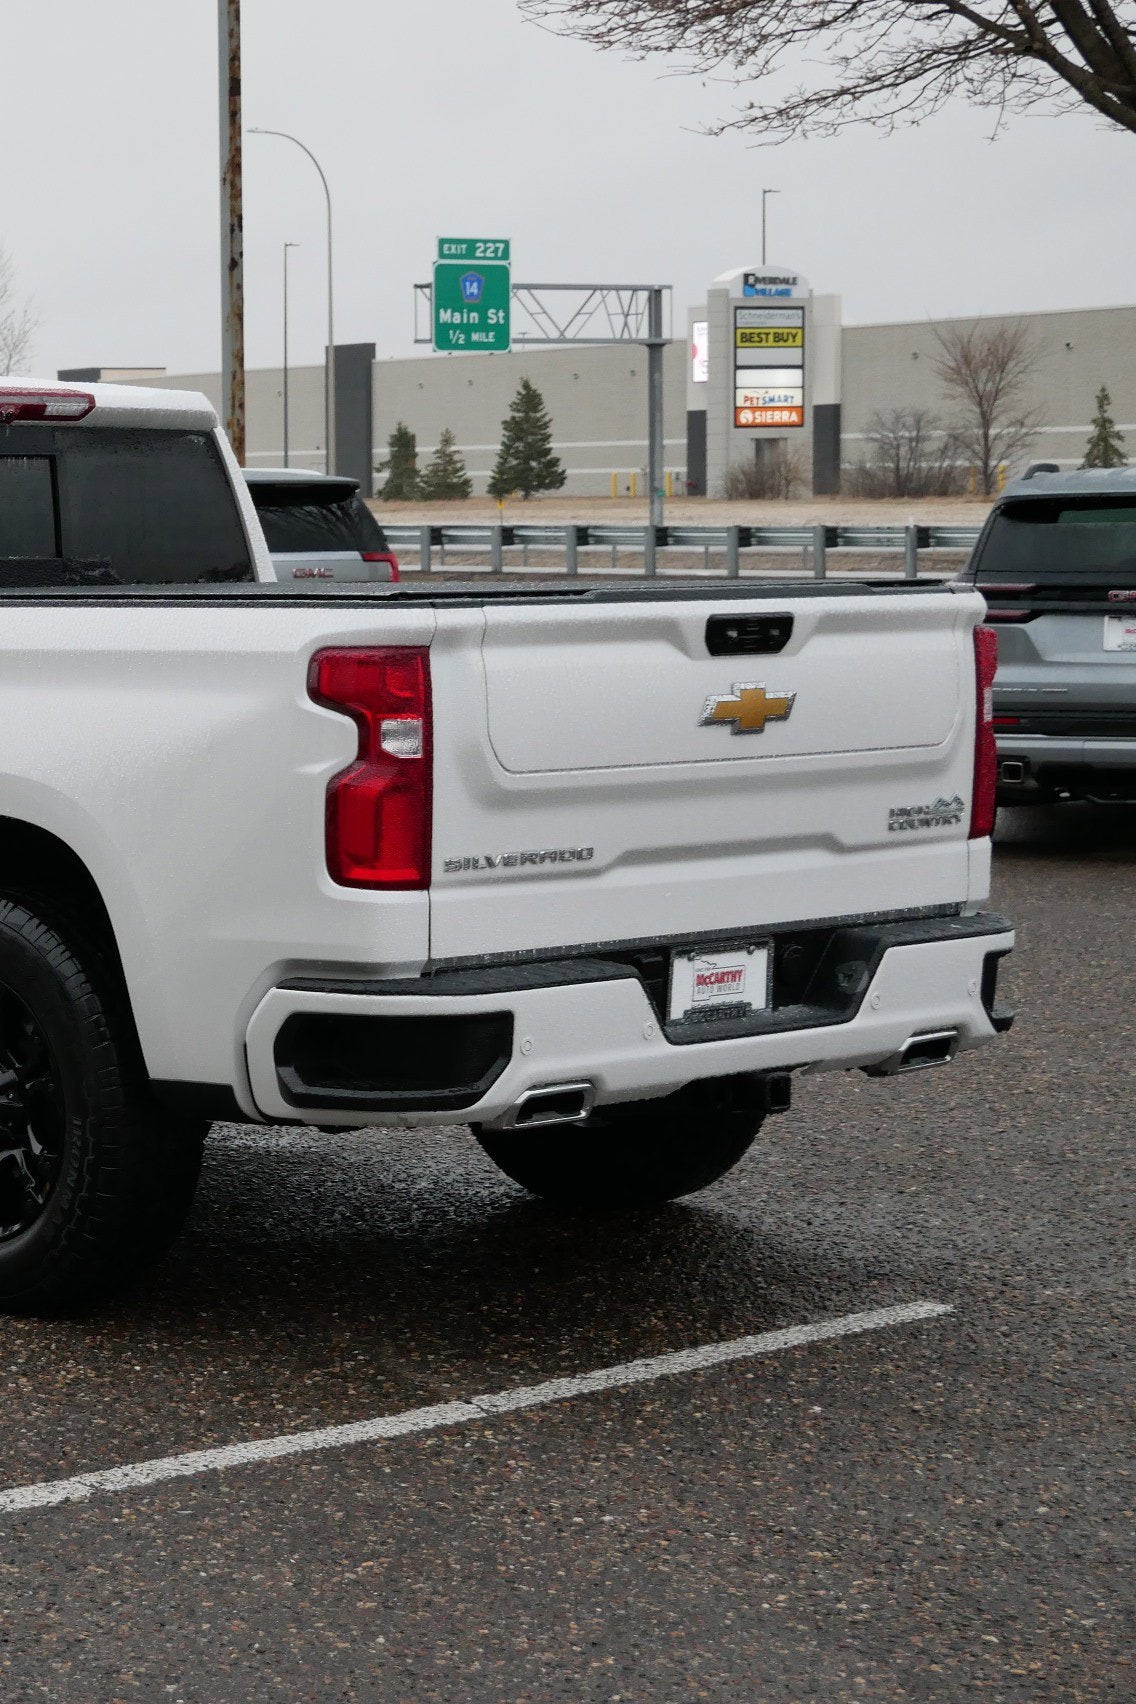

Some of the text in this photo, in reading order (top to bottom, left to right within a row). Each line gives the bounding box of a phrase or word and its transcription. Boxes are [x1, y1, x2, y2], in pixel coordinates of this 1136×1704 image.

[443, 242, 505, 257] EXIT 227
[465, 281, 479, 296] 14
[439, 308, 505, 324] Main St
[471, 332, 495, 342] MILE
[740, 332, 799, 343] BEST BUY
[754, 411, 798, 422] SIERRA
[292, 568, 334, 578] GMC
[443, 847, 594, 873] SILVERADO
[696, 969, 743, 987] McCARTHY
[697, 982, 741, 995] AUTO WORLD
